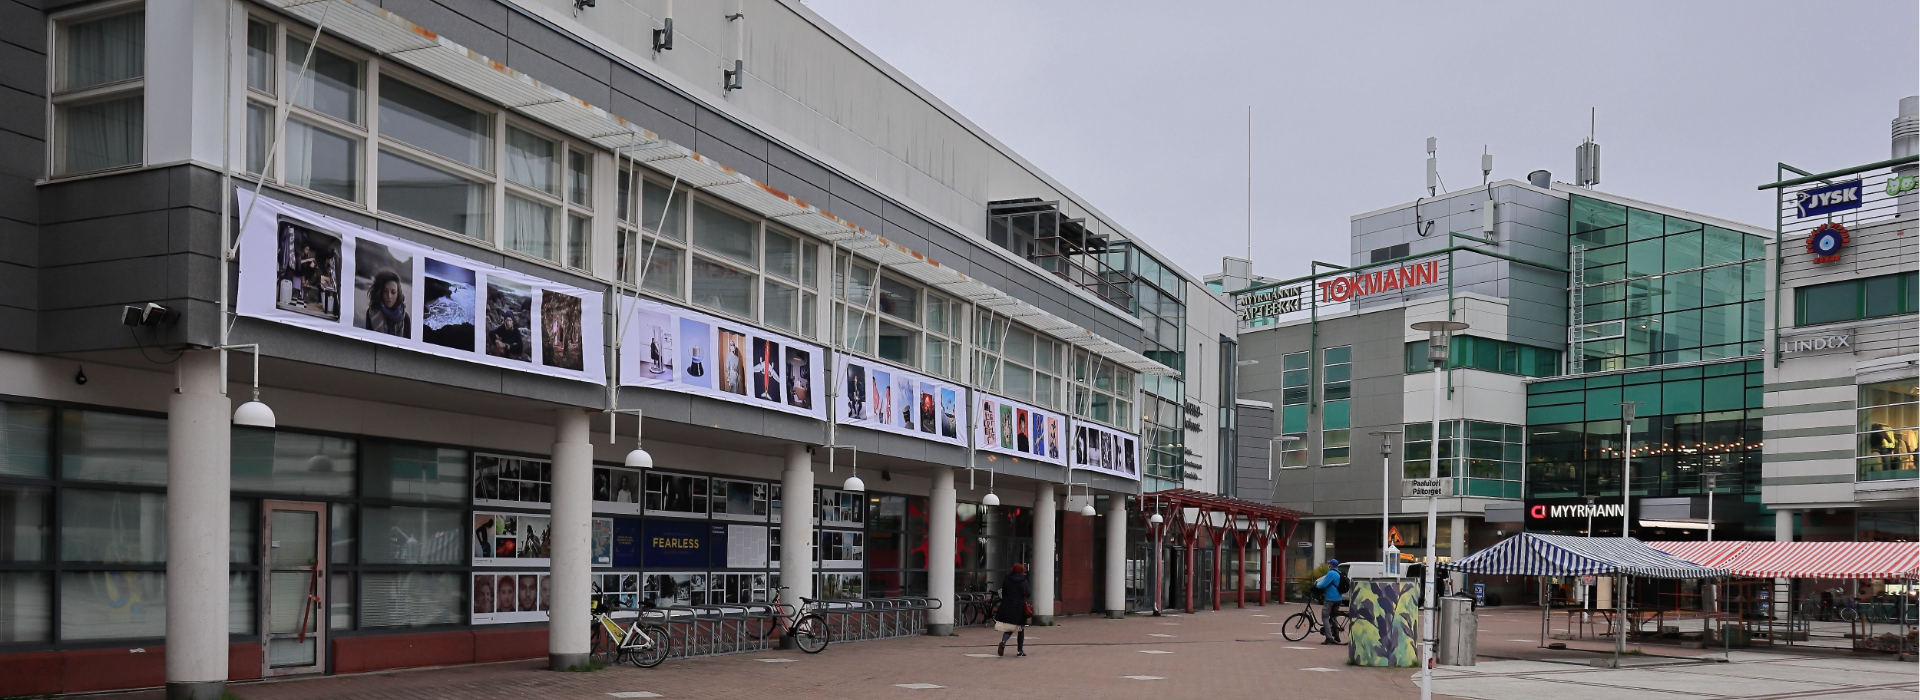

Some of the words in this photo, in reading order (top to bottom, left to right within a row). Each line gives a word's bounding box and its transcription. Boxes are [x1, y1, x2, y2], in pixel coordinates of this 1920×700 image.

[1808, 186, 1860, 210] JYSK
[1318, 260, 1438, 303] TOKMANNI
[1240, 286, 1300, 306] MYYRMANNIN
[1242, 299, 1300, 320] APTEEKKI
[1784, 334, 1850, 353] LINDEX
[1551, 504, 1624, 518] MYYRMANN
[652, 537, 700, 549] FEARLESS
